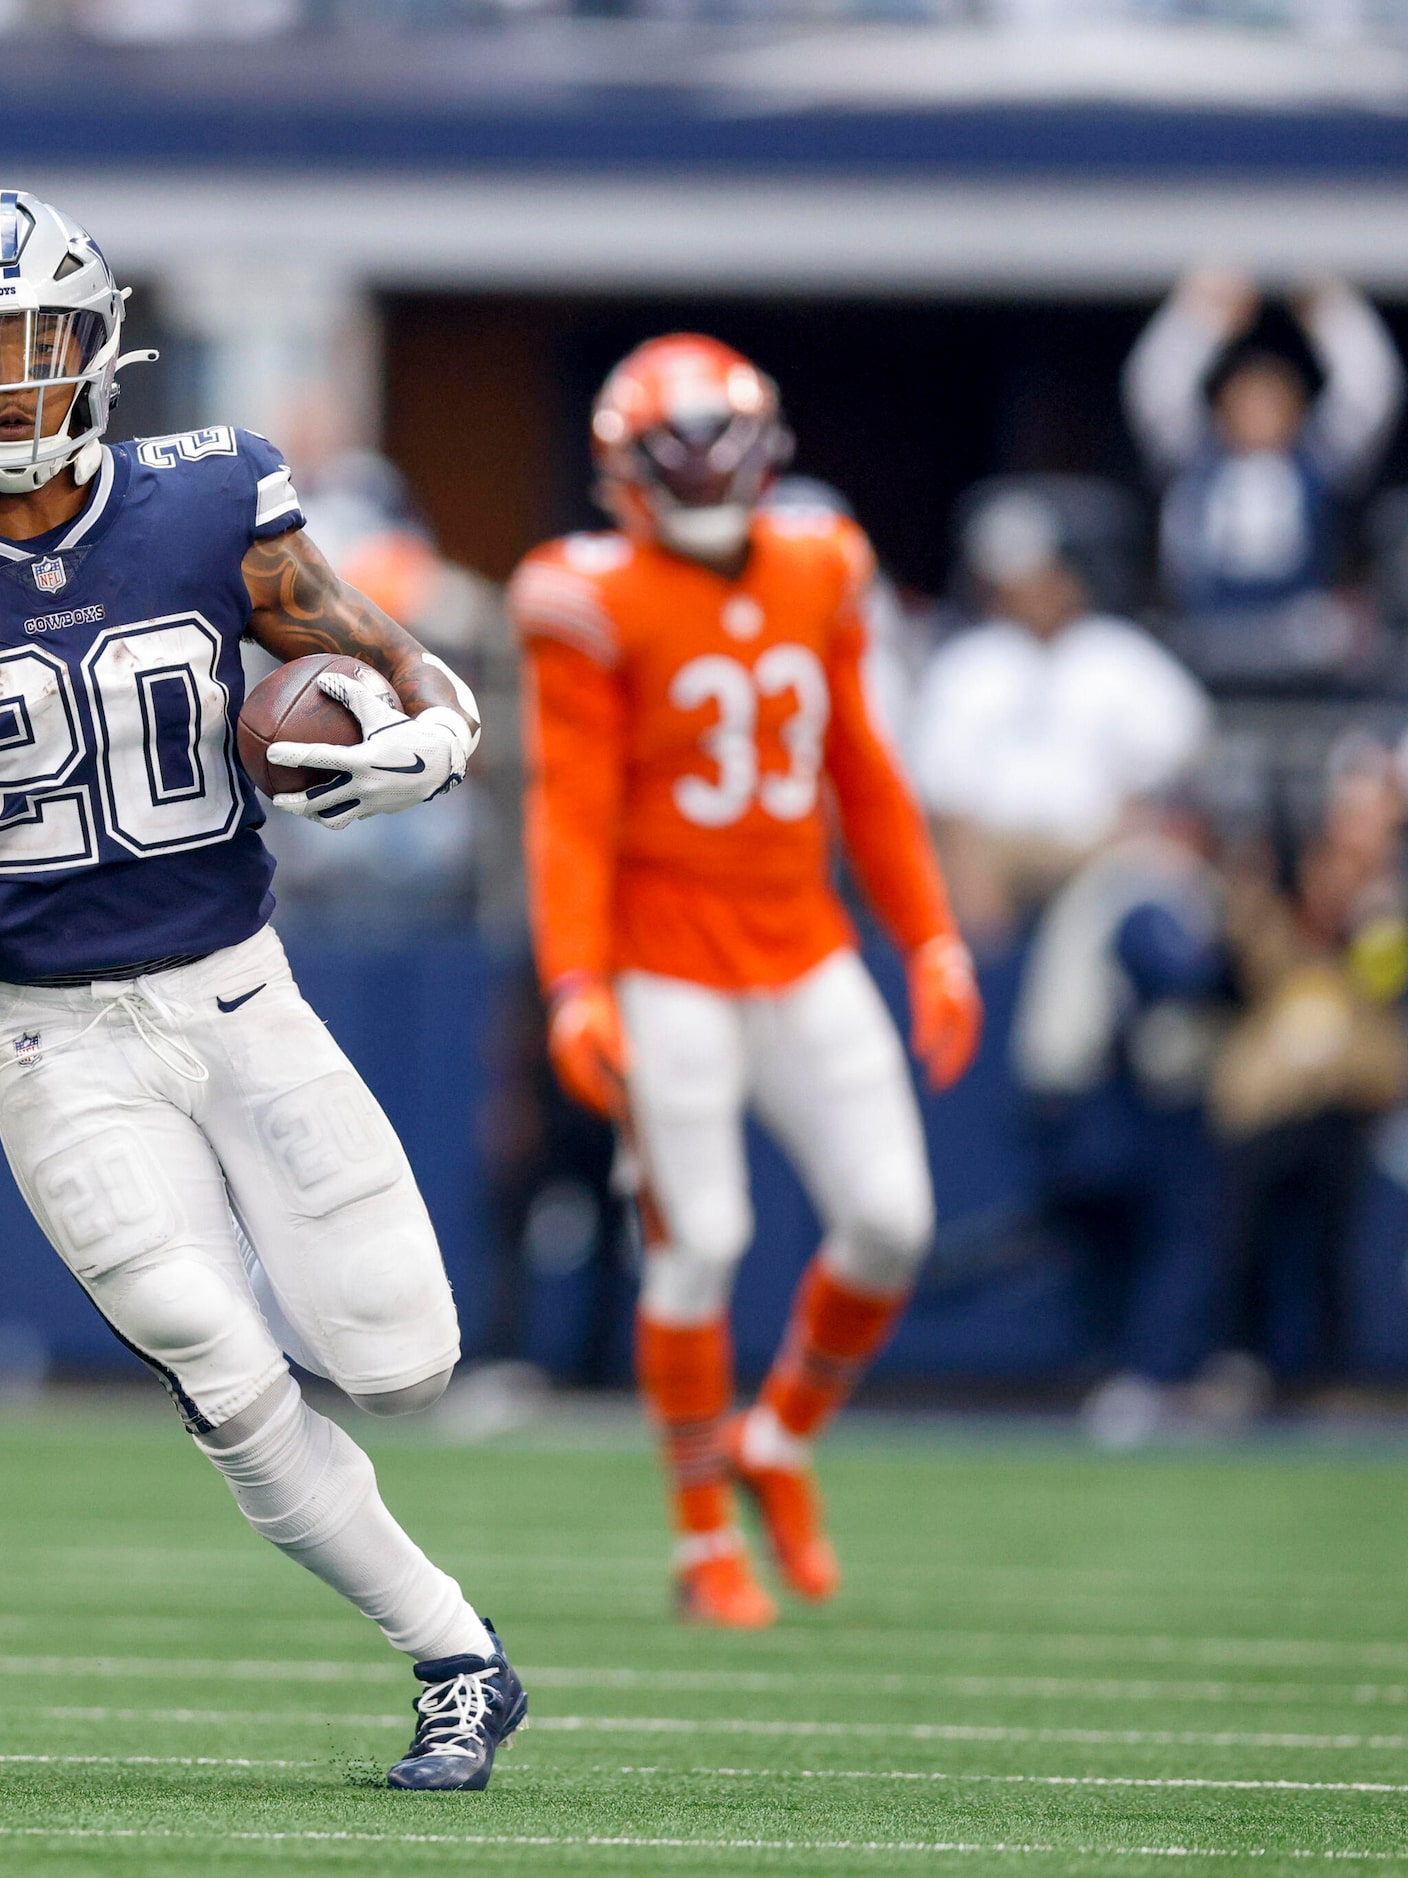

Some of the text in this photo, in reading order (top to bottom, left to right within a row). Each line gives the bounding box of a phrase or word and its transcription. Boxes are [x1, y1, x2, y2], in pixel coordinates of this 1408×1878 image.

[39, 571, 61, 587] NFL
[24, 604, 105, 634] COWBOYS
[669, 642, 831, 828] 33
